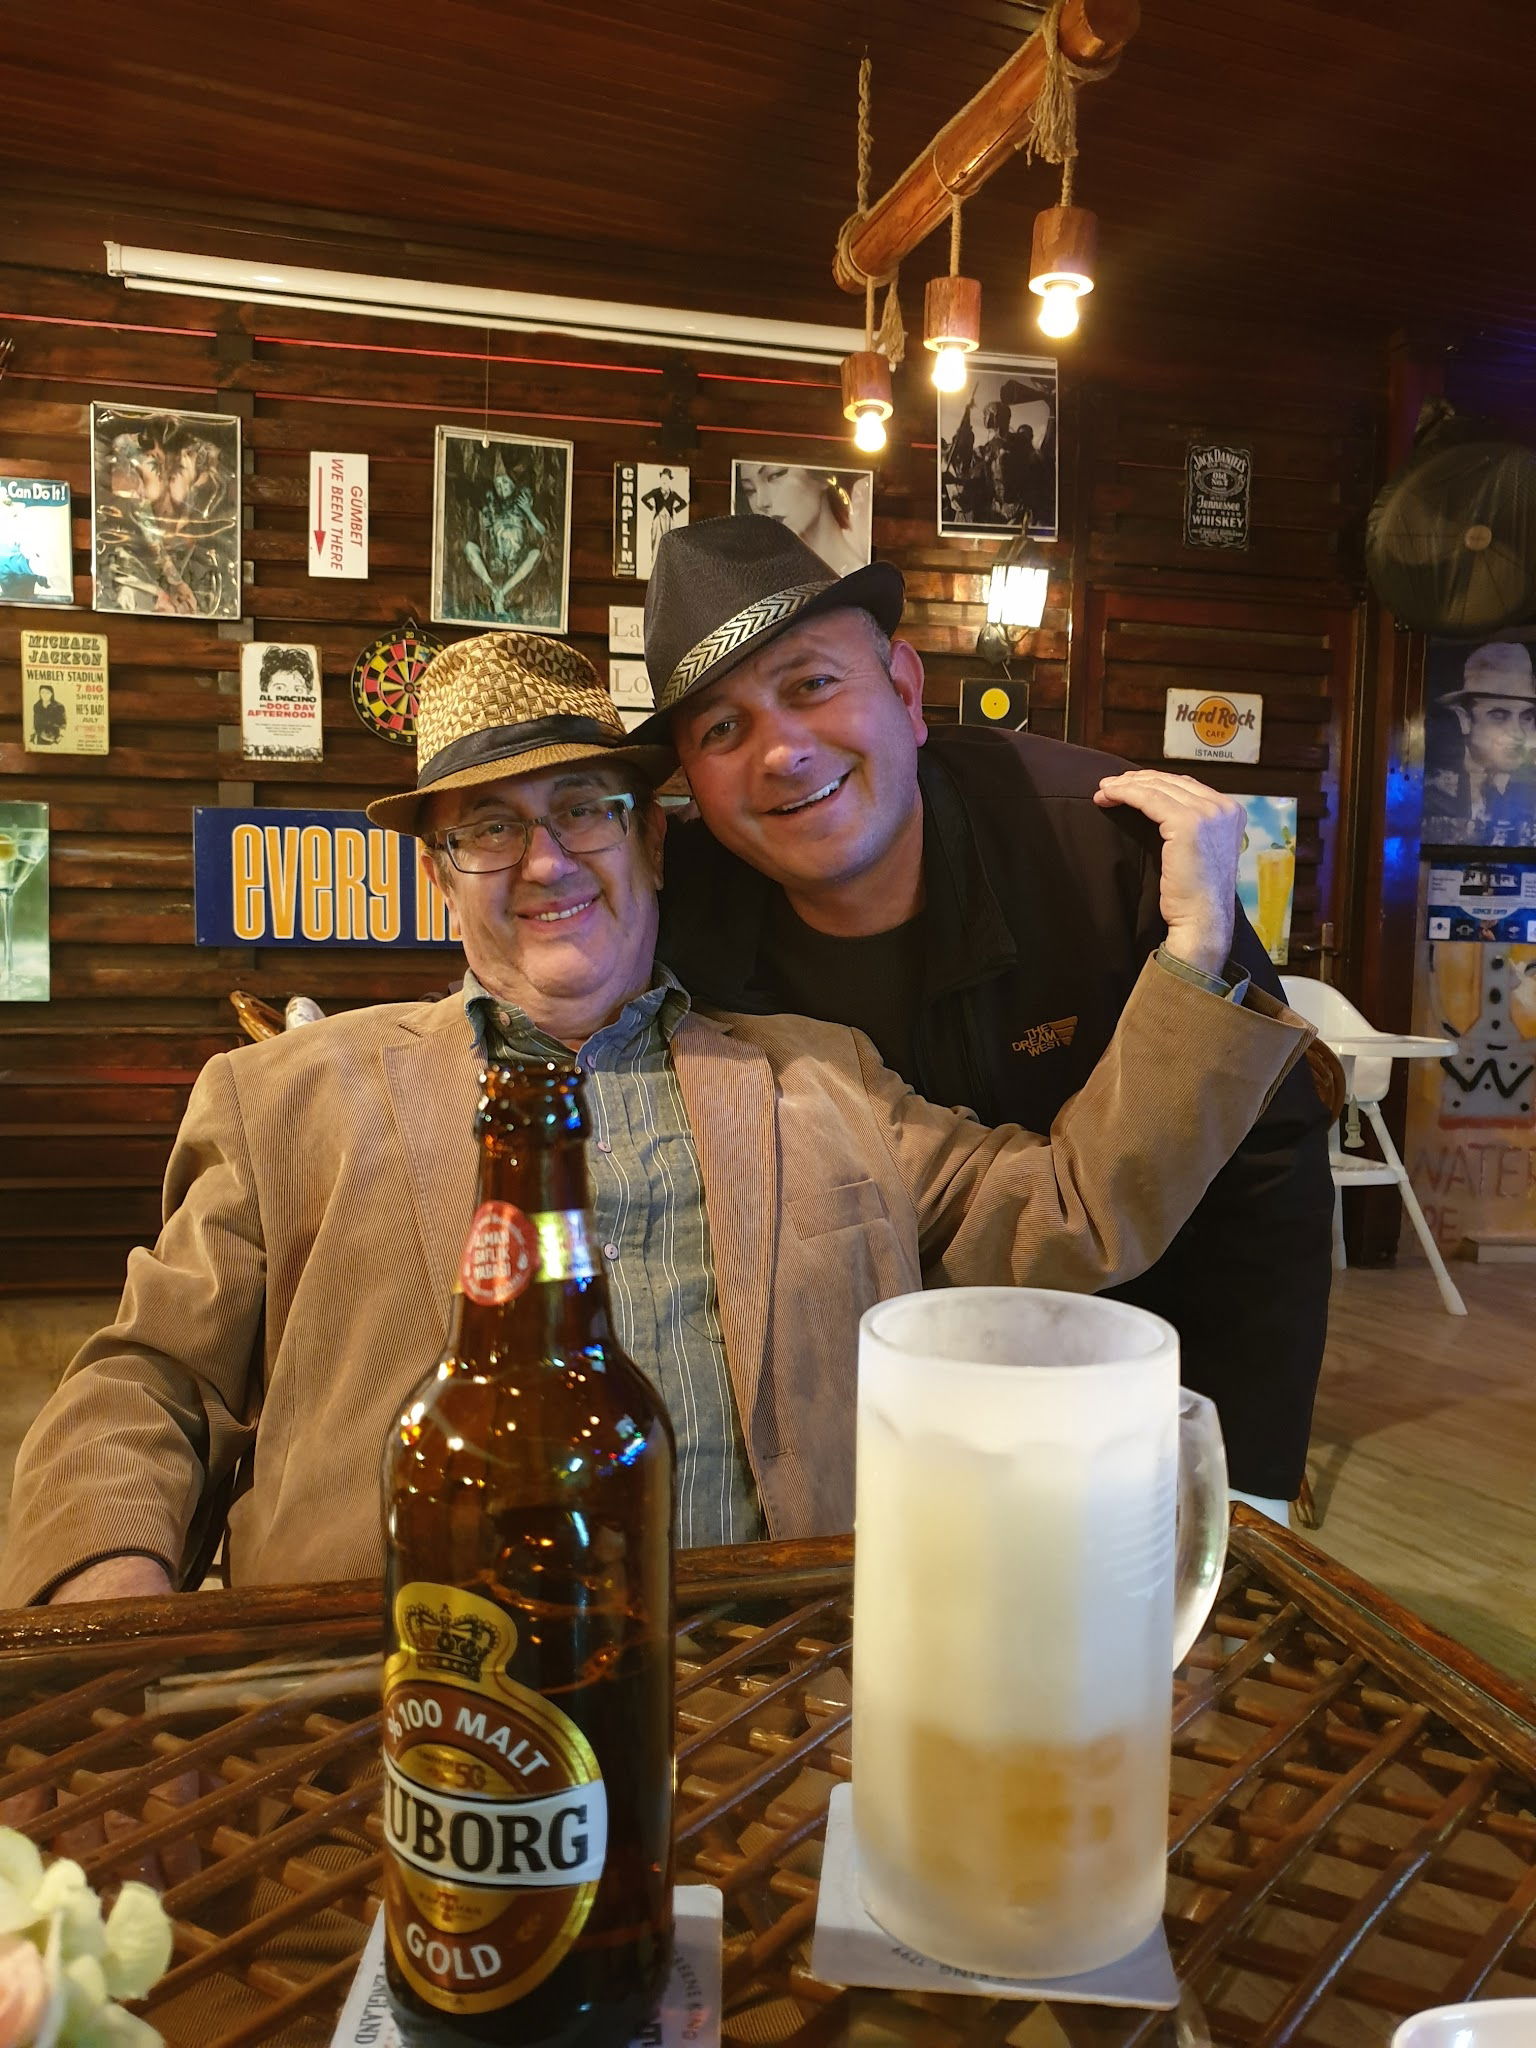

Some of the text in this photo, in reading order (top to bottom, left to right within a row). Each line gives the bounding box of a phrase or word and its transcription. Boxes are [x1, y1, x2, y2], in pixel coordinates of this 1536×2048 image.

[1193, 451, 1214, 471] JACK
[8, 481, 31, 499] Can
[33, 483, 50, 500] Do
[52, 484, 66, 501] It!
[330, 459, 344, 571] WE BEEN THERE
[621, 467, 634, 563] CHAPLIN
[1192, 514, 1245, 529] WHISKEY
[28, 635, 100, 651] MICHAEL
[28, 650, 102, 666] JACKSON
[26, 669, 104, 683] WEMBLEY STADIUM
[76, 684, 82, 692] 7
[248, 710, 316, 719] AFTERNOON
[1175, 703, 1256, 730] Hard Rock
[1205, 730, 1226, 738] CAFE
[1011, 1029, 1057, 1052] DREAM
[1023, 1023, 1050, 1040] THE
[1027, 1040, 1061, 1057] WEST
[386, 1698, 443, 1744] %100
[454, 1706, 550, 1777] MALT
[388, 1779, 588, 1875] UBORG
[406, 1921, 502, 1980] GOLD
[353, 1973, 388, 2046] ENGLAND
